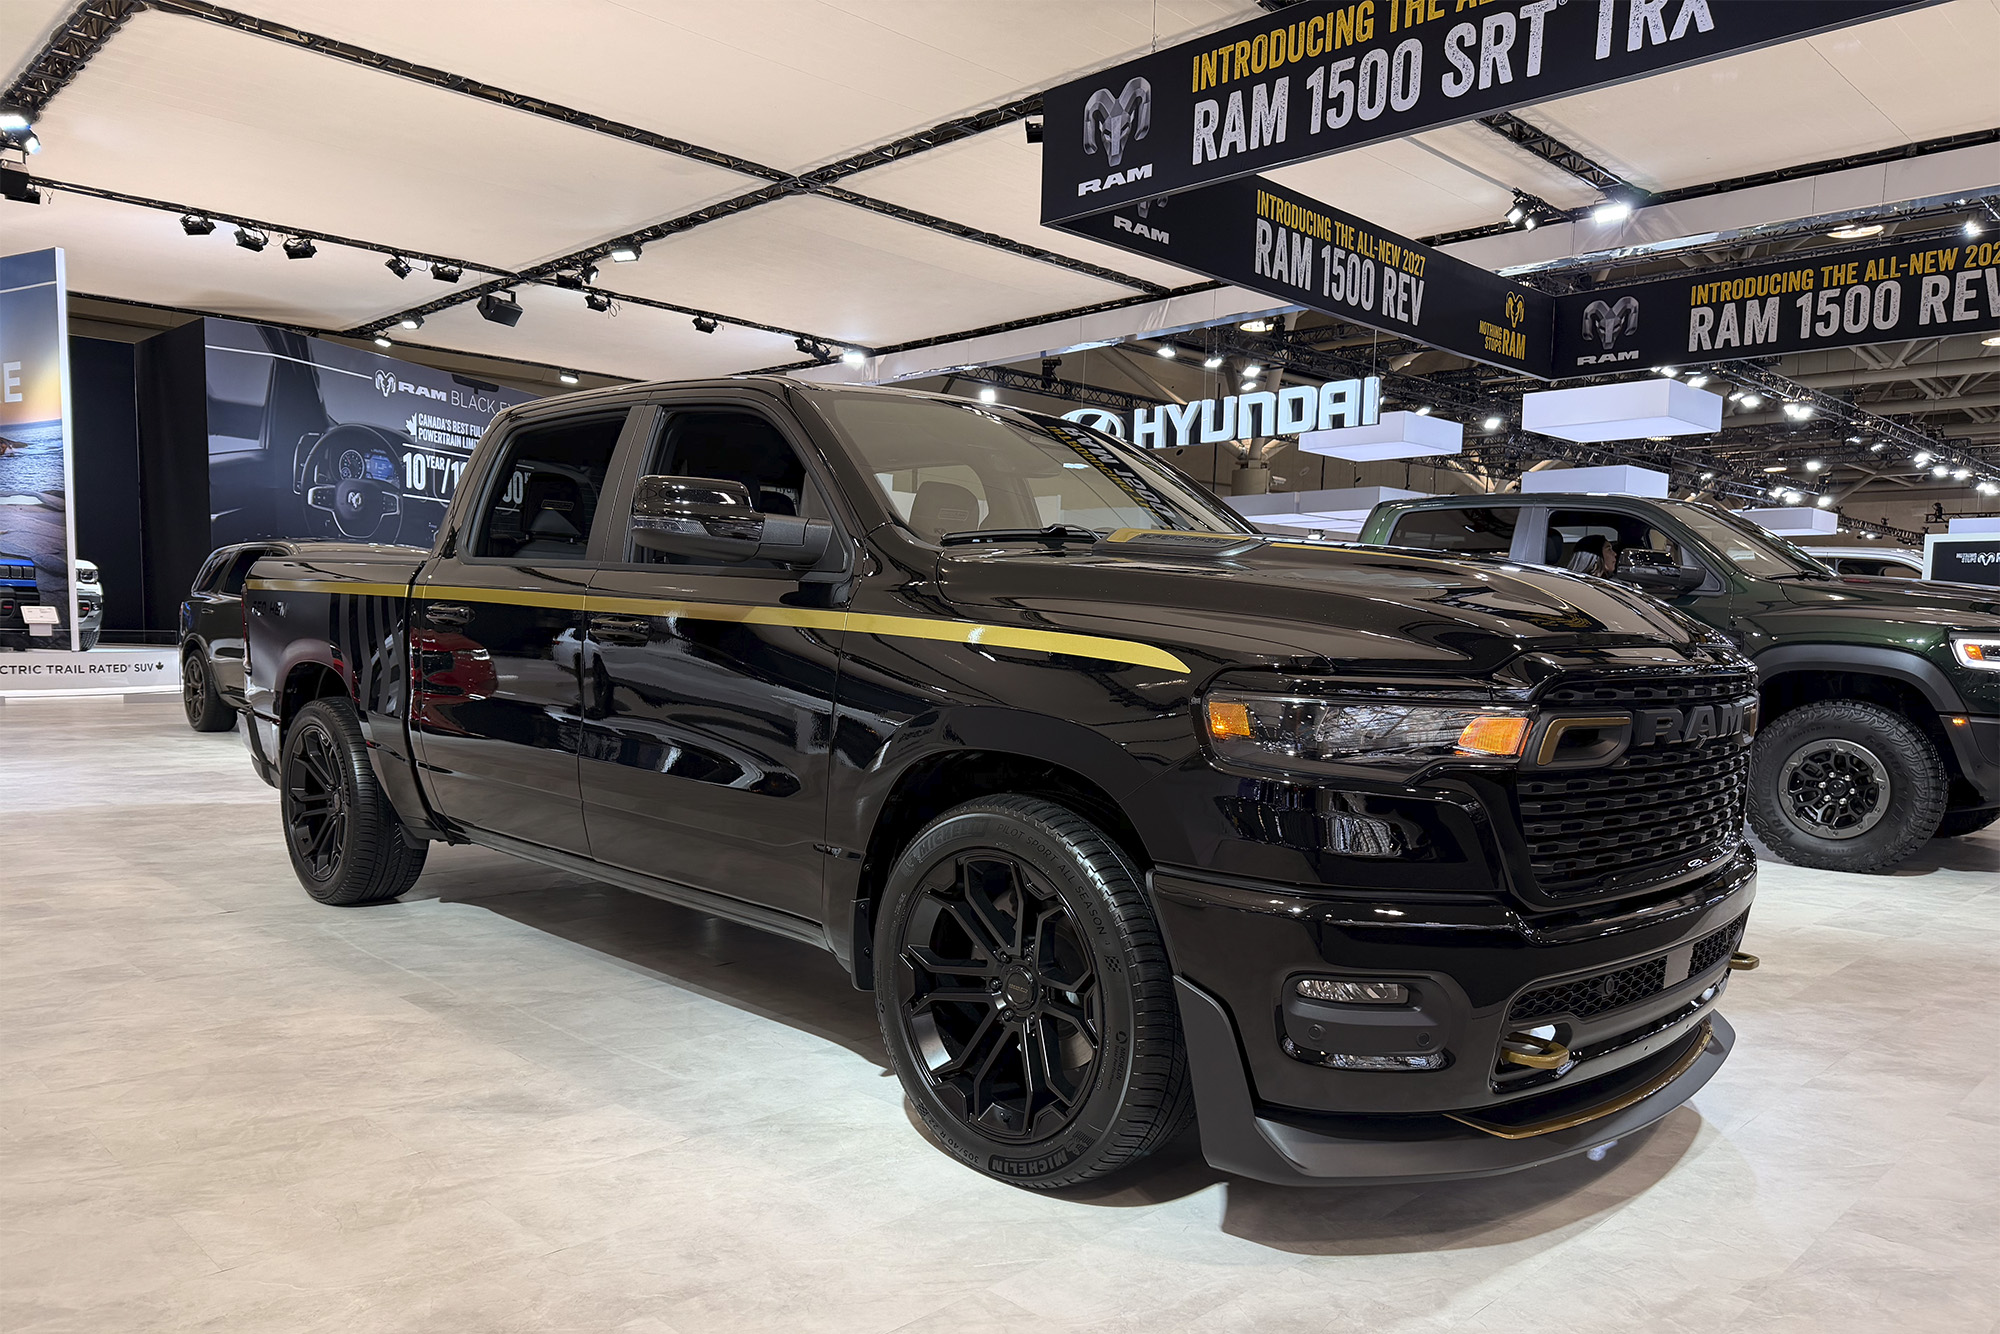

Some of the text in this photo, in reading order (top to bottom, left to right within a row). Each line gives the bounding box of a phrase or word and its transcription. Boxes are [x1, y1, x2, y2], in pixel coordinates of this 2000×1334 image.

[1192, 0, 1375, 93] INTRODUCING
[1192, 76, 1290, 166] RAM
[1306, 38, 1424, 135] 1500
[1441, 0, 1557, 98] SRT
[1078, 164, 1153, 197] RAM
[1114, 215, 1170, 245] RAM
[1256, 189, 1426, 278] INTRODUCING THE ALL-NEW 2027
[1254, 217, 1425, 326] RAM 1500 REV
[1690, 268, 1815, 306] INTRODUCING
[1820, 262, 1859, 287] THE
[1864, 247, 1959, 282] ALL-NEW
[1688, 267, 2000, 352] RAM 1500 REV
[1479, 320, 1503, 340] NOTHING
[1484, 328, 1526, 360] STOPS RAM
[1577, 349, 1639, 366] RAM
[398, 381, 447, 402] RAM
[451, 390, 496, 415] BLACK
[1133, 376, 1382, 448] HYUNDAI
[418, 413, 451, 431] CANADA'S
[452, 420, 469, 435] BEST
[418, 427, 462, 448] POWERTRAIN
[46, 664, 86, 674] TRAIL
[134, 663, 154, 673] SUV
[1635, 702, 1745, 746] RAM
[997, 823, 1025, 839] PILOT
[1027, 836, 1058, 862] SPORT
[1058, 864, 1075, 883] ALL
[1075, 885, 1107, 936] SEASON
[992, 1150, 1069, 1176] MICHELIN
